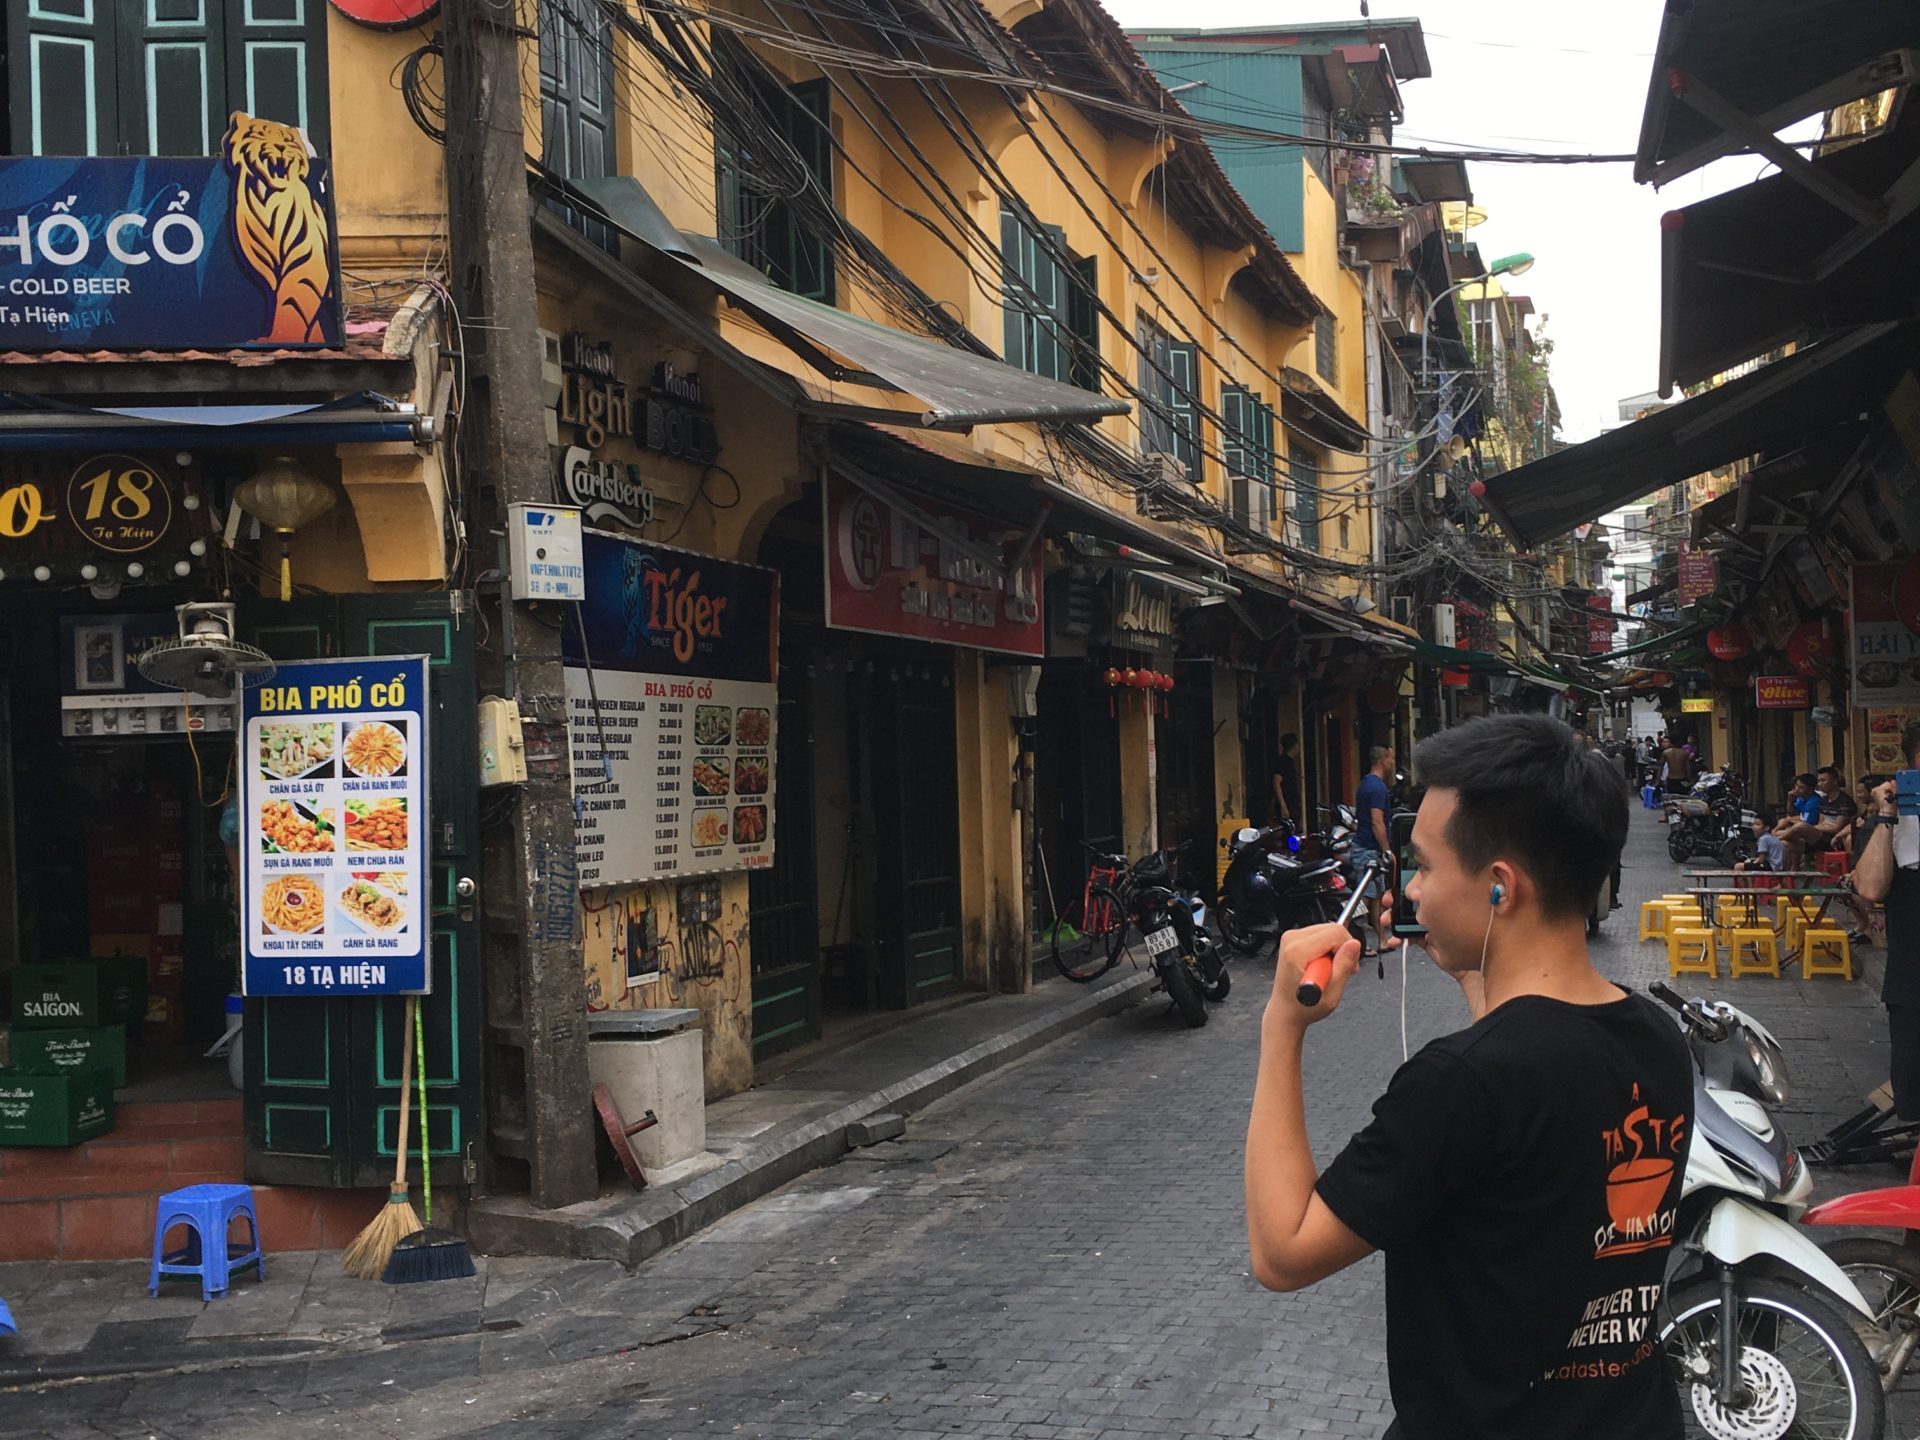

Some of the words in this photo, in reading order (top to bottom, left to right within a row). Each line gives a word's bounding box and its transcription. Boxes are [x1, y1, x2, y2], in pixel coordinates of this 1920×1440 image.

[106, 190, 204, 265] CỔ
[10, 278, 69, 295] COLD
[73, 278, 131, 295] BEER
[25, 306, 70, 326] Hiện
[574, 335, 616, 378] Hanoi
[665, 360, 703, 404] Hanoi
[562, 370, 632, 449] Light
[564, 446, 655, 522] Carlsberg
[80, 469, 154, 520] 18
[643, 567, 727, 663] Tiger
[260, 687, 302, 711] BIA
[310, 675, 362, 710] PHỐ
[370, 672, 406, 707] CỔ
[645, 682, 667, 697] BIA
[670, 680, 694, 698] PHỐ
[697, 680, 713, 699] CỔ
[1762, 686, 1806, 699] Olive
[575, 699, 586, 709] BIA
[587, 699, 618, 710] HNEKEN
[619, 701, 645, 711] REGULAR
[659, 703, 678, 713] 25.000
[574, 716, 585, 726] BIA
[587, 716, 617, 727] HEIEKEN
[618, 717, 639, 728] SILVER
[659, 719, 677, 728] 25.000
[573, 733, 584, 743] BIA
[586, 733, 602, 743] TIGE
[605, 733, 632, 744] REGULAR
[658, 735, 677, 744] 25.000
[573, 750, 584, 760] BIA
[606, 751, 629, 761] RYSTAL
[658, 751, 676, 760] 25.000
[574, 767, 606, 777] TRONGBO
[657, 766, 675, 776] 25.000
[607, 783, 619, 793] LON
[657, 782, 675, 791] 15.000
[590, 800, 611, 811] CHANH
[583, 834, 605, 845] CHANH
[347, 856, 365, 866] NEM
[367, 856, 387, 865] CHUA
[592, 850, 604, 862] LEO
[291, 857, 312, 868] RANG
[582, 867, 600, 880] ATISO
[263, 940, 285, 950] KHOAI
[378, 938, 398, 948] RANG
[283, 967, 306, 985] 18
[310, 966, 335, 988] TẠ
[340, 962, 385, 988] HIỆN
[42, 992, 60, 1002] BIA
[23, 1002, 81, 1017] SAIGON
[1631, 1081, 1640, 1104] A
[1602, 1105, 1685, 1172] TASTE
[1594, 1220, 1616, 1252] OF
[1626, 1207, 1677, 1240] HANOI
[1581, 1288, 1633, 1323] NEVER
[1638, 1285, 1661, 1312] TR
[1566, 1318, 1623, 1349] NEVER
